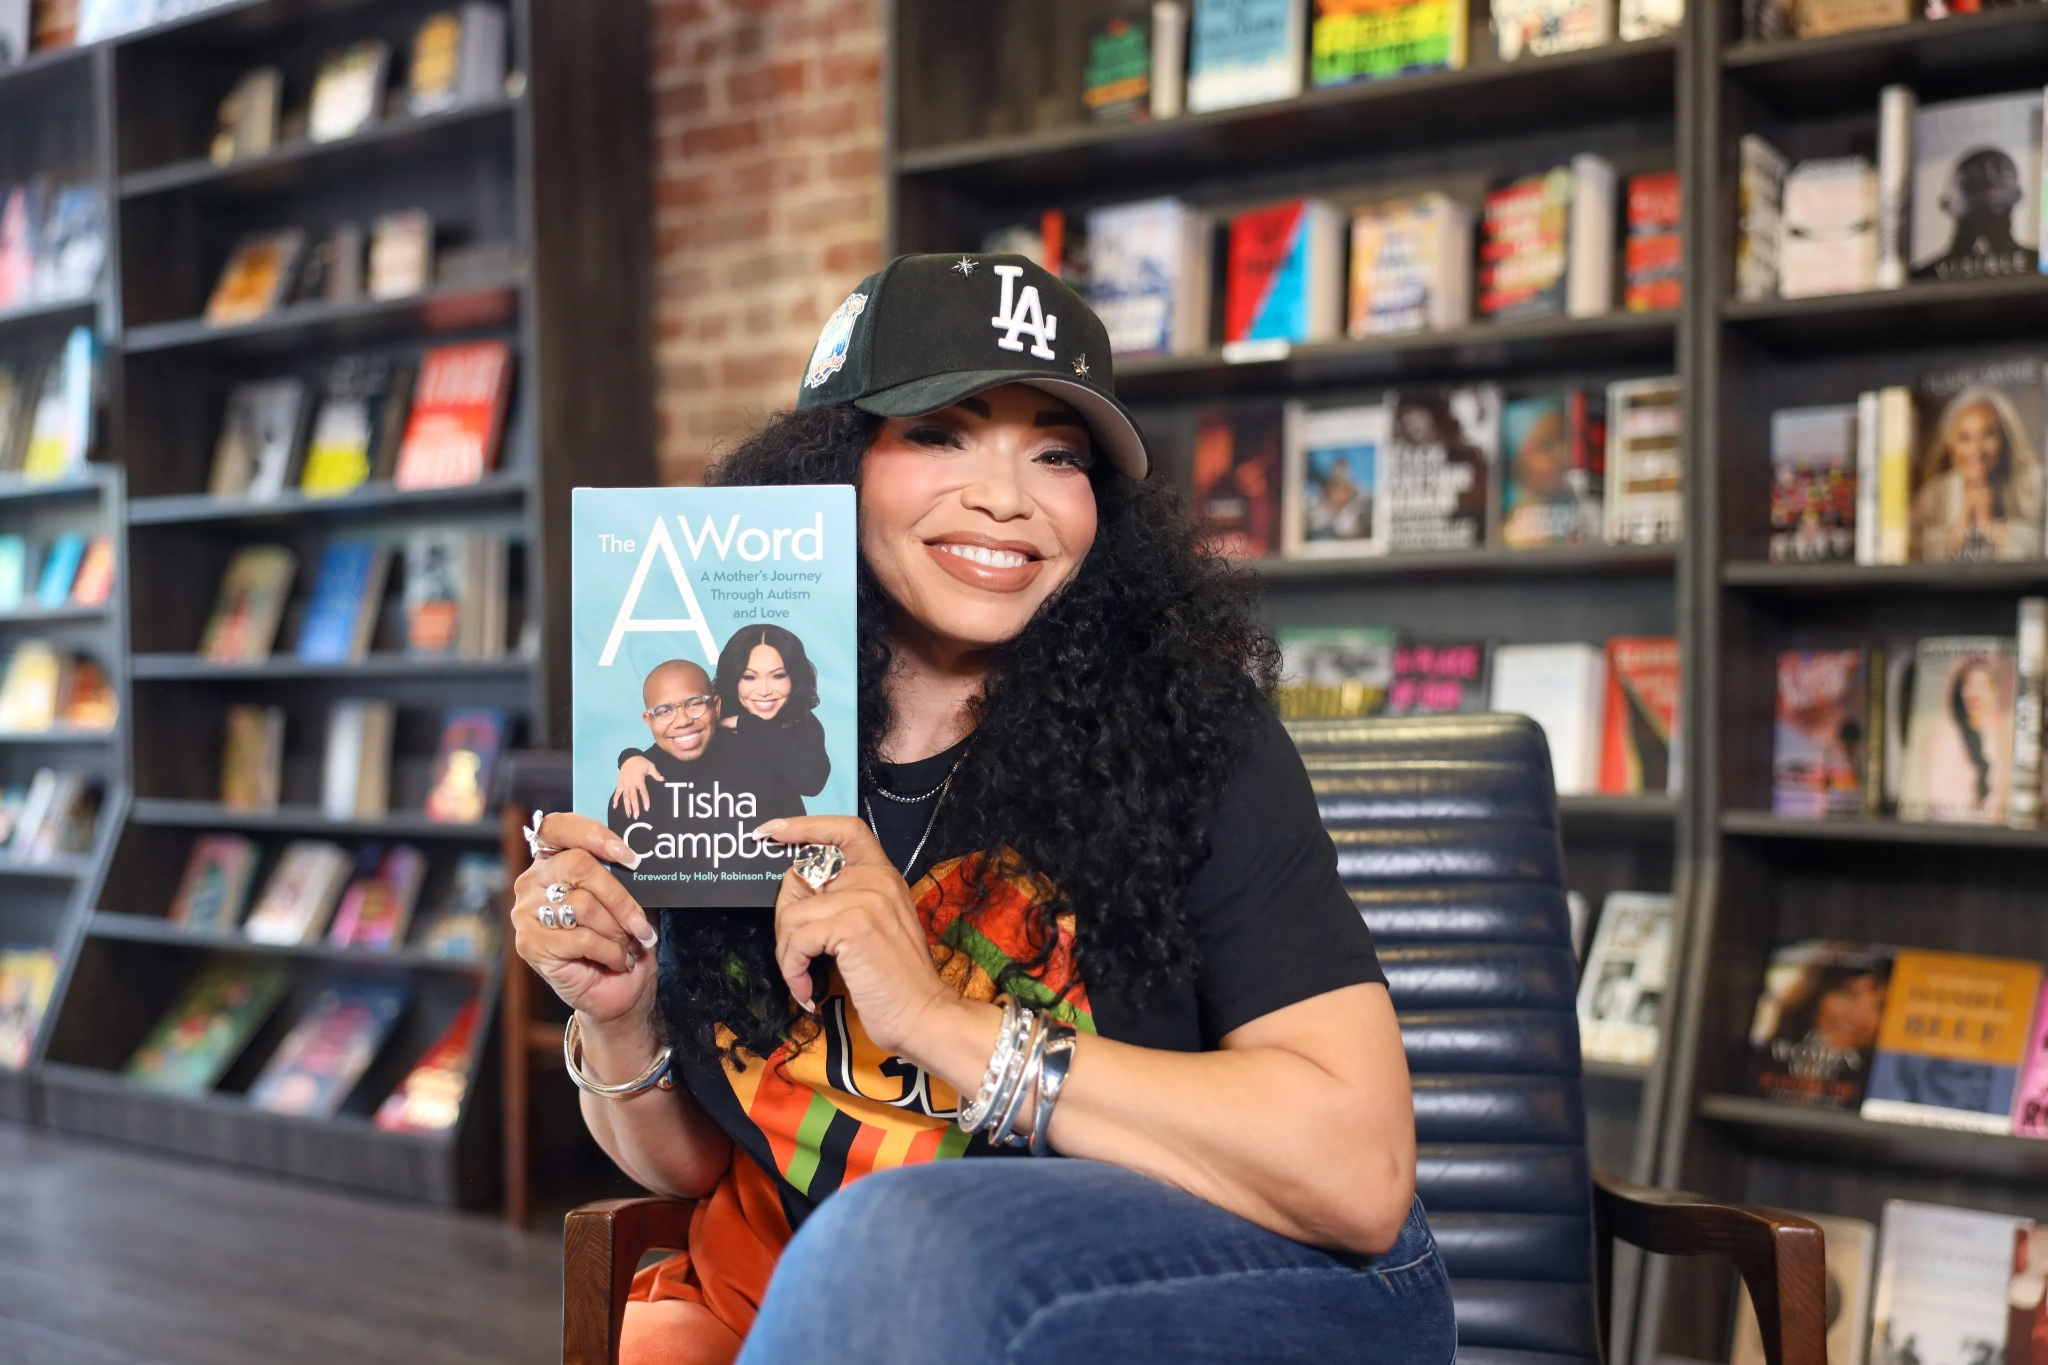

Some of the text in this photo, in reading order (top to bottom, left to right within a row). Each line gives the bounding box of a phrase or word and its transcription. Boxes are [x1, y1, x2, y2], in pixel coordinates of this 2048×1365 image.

[991, 265, 1057, 361] LA
[700, 570, 822, 584] A Mother's Journey
[598, 511, 824, 666] The A Word
[710, 588, 810, 603] Through Autism
[733, 607, 790, 618] and Love
[664, 780, 757, 818] Tisha
[633, 871, 678, 882] Foreword
[680, 871, 692, 884] by
[694, 871, 719, 883] Holly
[721, 871, 764, 882] Robinson
